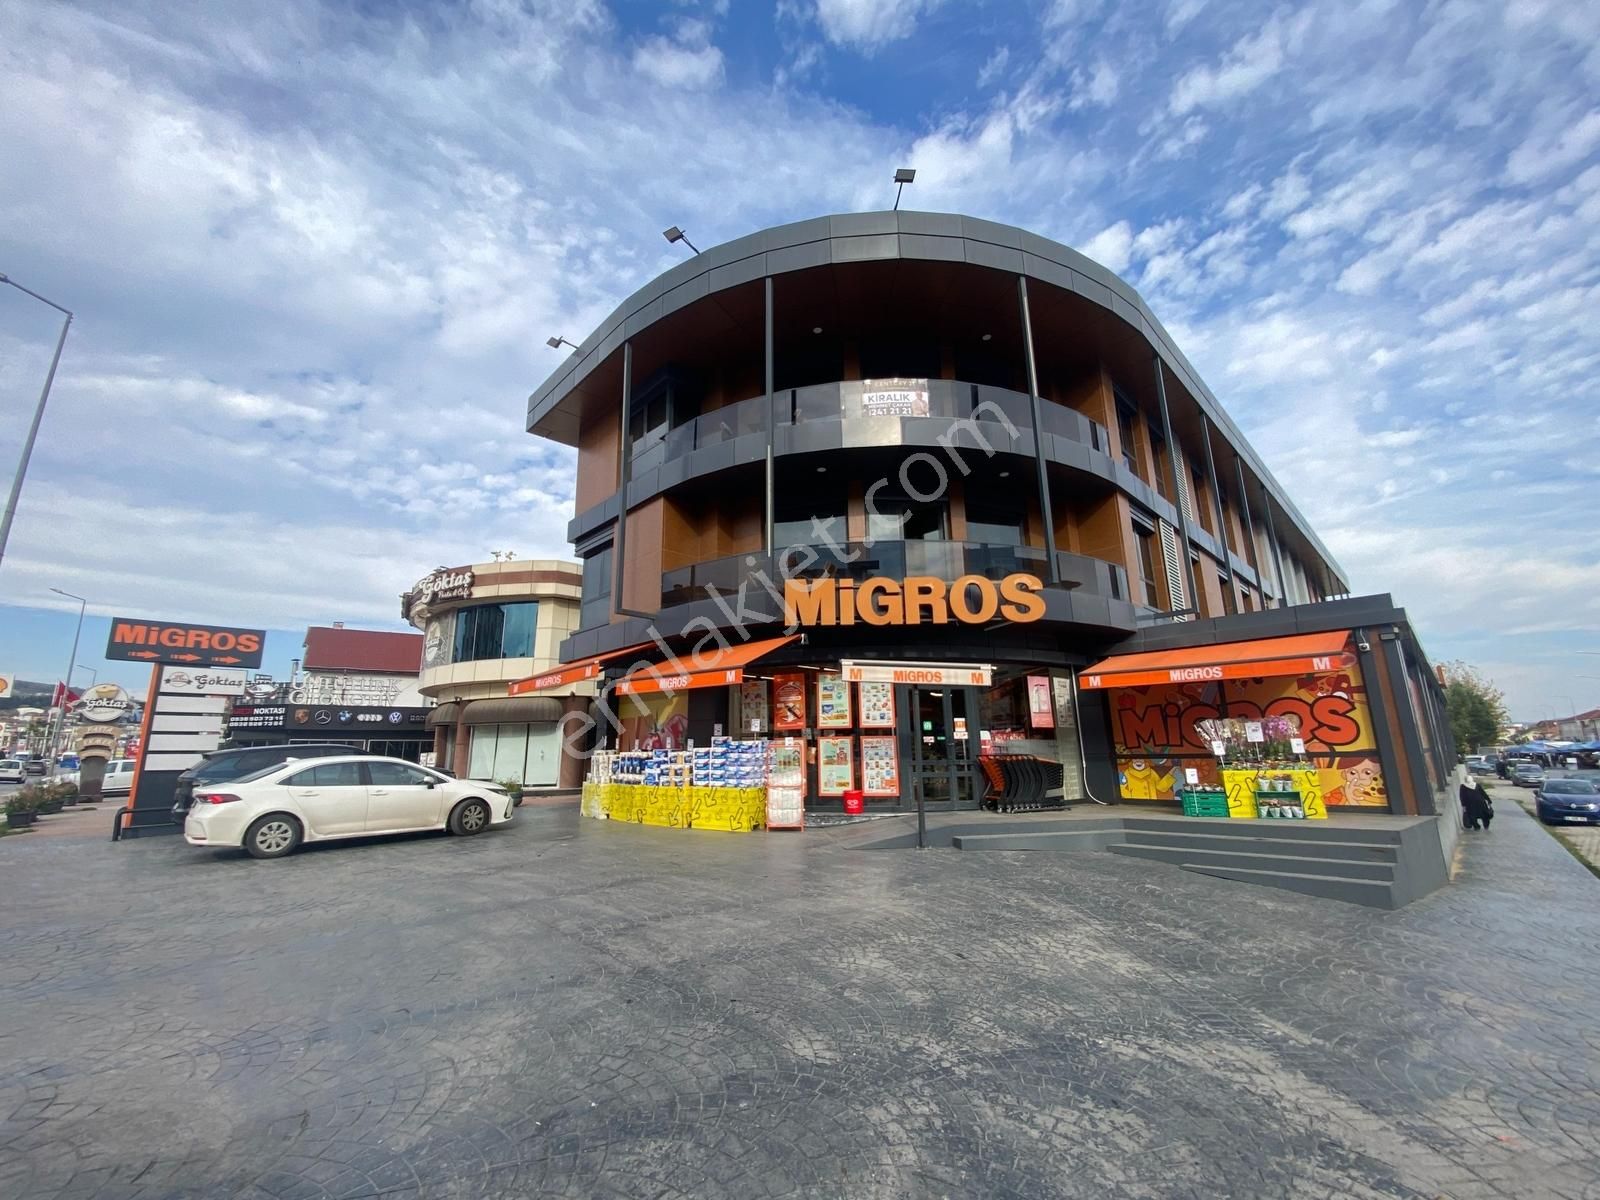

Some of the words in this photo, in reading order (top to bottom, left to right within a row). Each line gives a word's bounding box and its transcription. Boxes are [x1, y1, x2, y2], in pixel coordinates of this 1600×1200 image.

[1313, 657, 1331, 671] M
[726, 671, 736, 682] M
[849, 668, 862, 680] M
[971, 672, 984, 684] M
[1089, 676, 1101, 687] M
